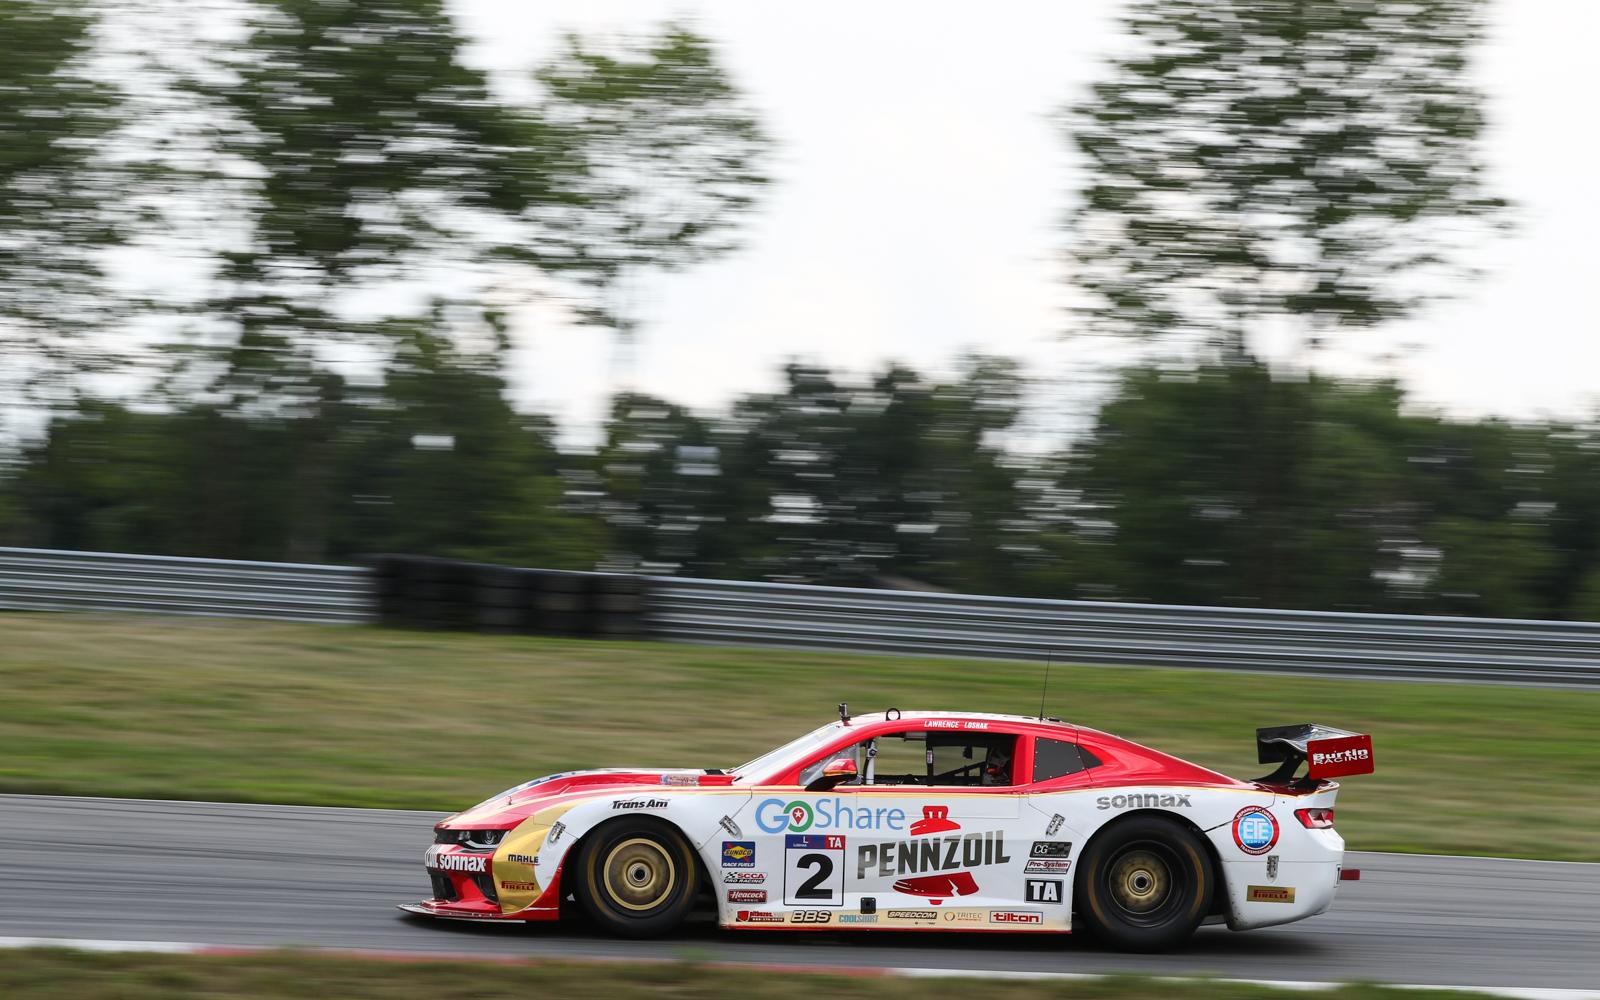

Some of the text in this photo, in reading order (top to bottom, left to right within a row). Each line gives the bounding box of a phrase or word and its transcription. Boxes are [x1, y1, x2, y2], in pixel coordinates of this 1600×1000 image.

[924, 720, 959, 729] LAWRENCE
[1313, 749, 1368, 761] Burtin
[1313, 755, 1369, 766] RACING
[612, 799, 669, 810] Trans Am
[1096, 793, 1192, 810] sonnax
[1242, 817, 1270, 840] ETE
[828, 837, 842, 848] TA
[724, 849, 753, 857] SUNOCO
[1034, 844, 1049, 854] CG
[508, 854, 539, 863] MAHLE
[857, 830, 1011, 880] PENNZOIL
[439, 855, 486, 872] sonnax
[1029, 861, 1069, 869] Pro-System
[795, 853, 833, 899] 2
[501, 881, 535, 891] PIRELLI
[1030, 881, 1058, 901] TA
[731, 891, 765, 899] Heacock
[1254, 889, 1289, 899] PIRELLI
[791, 909, 832, 923] BBS
[888, 911, 937, 919] SPEEDCOM
[992, 912, 1040, 923] tilton
